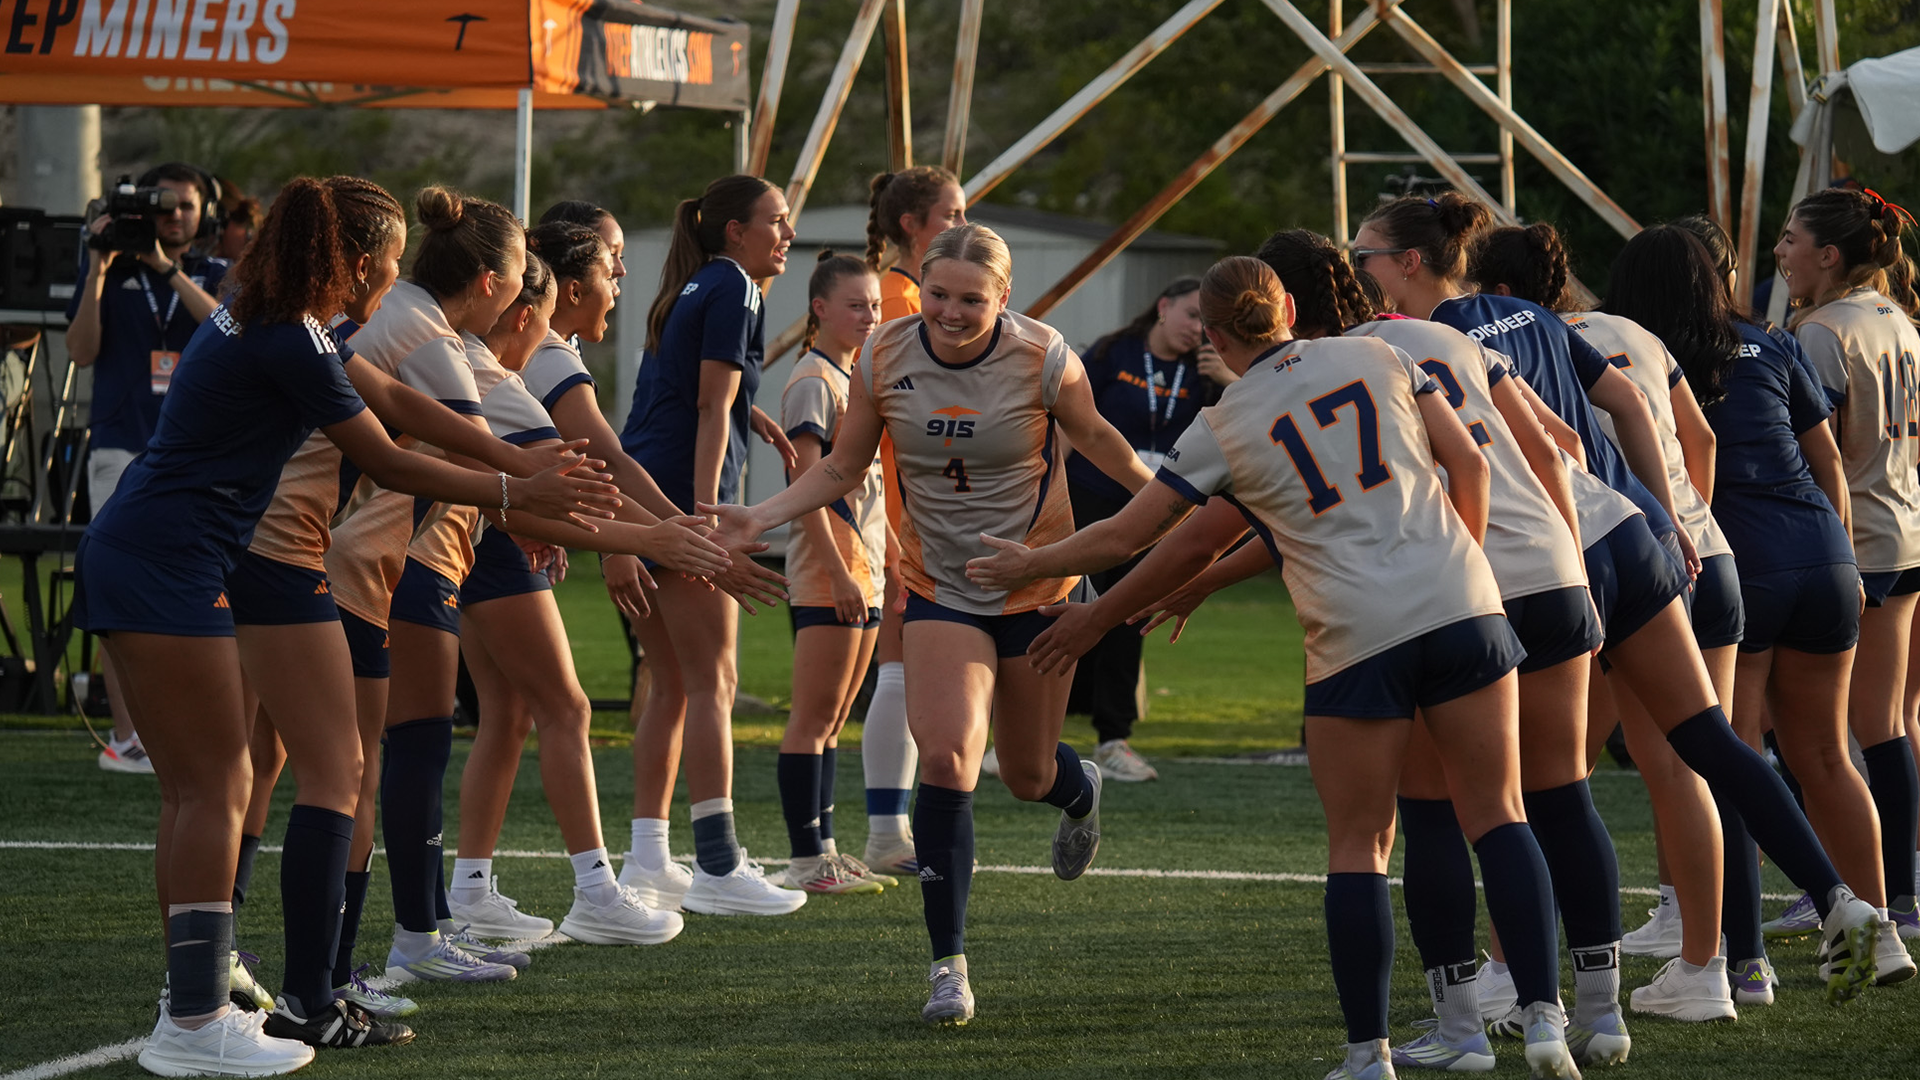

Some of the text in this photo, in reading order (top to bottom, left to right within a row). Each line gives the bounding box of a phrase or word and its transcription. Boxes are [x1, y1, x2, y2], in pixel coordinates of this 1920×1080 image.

[1739, 344, 1761, 358] EP
[926, 419, 975, 438] 915
[1268, 378, 1394, 519] 17
[942, 458, 971, 494] 4
